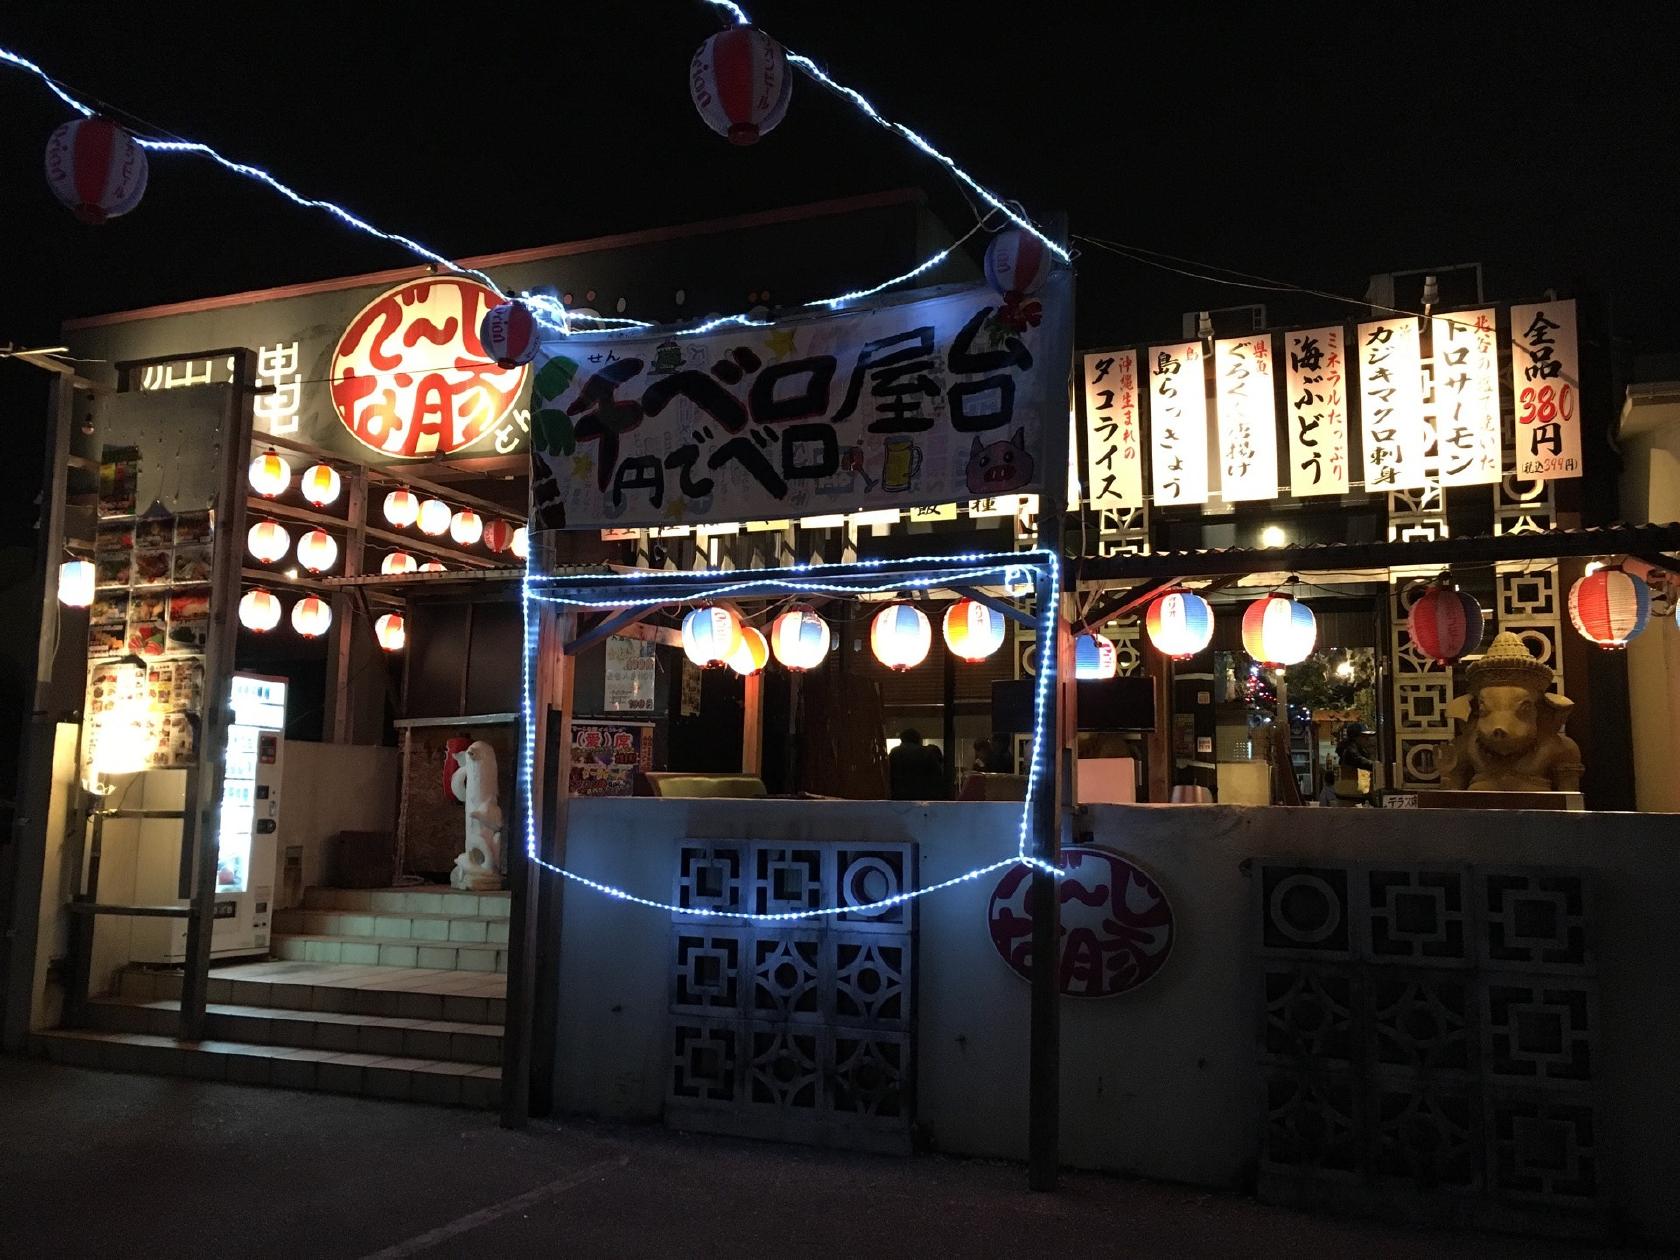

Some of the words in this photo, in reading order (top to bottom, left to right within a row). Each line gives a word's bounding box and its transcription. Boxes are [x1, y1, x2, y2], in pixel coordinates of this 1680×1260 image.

[567, 306, 1033, 493] 千ベロ屋台
[587, 350, 621, 365] せん
[1092, 357, 1123, 500] タコライス
[1152, 350, 1185, 499] 島らっきょう
[1290, 335, 1326, 485] 海ぶどう
[1325, 331, 1343, 482] ミネラルたっぷり
[1366, 325, 1403, 486] カジキマグロ刺身
[1443, 319, 1475, 477] トロサーモン
